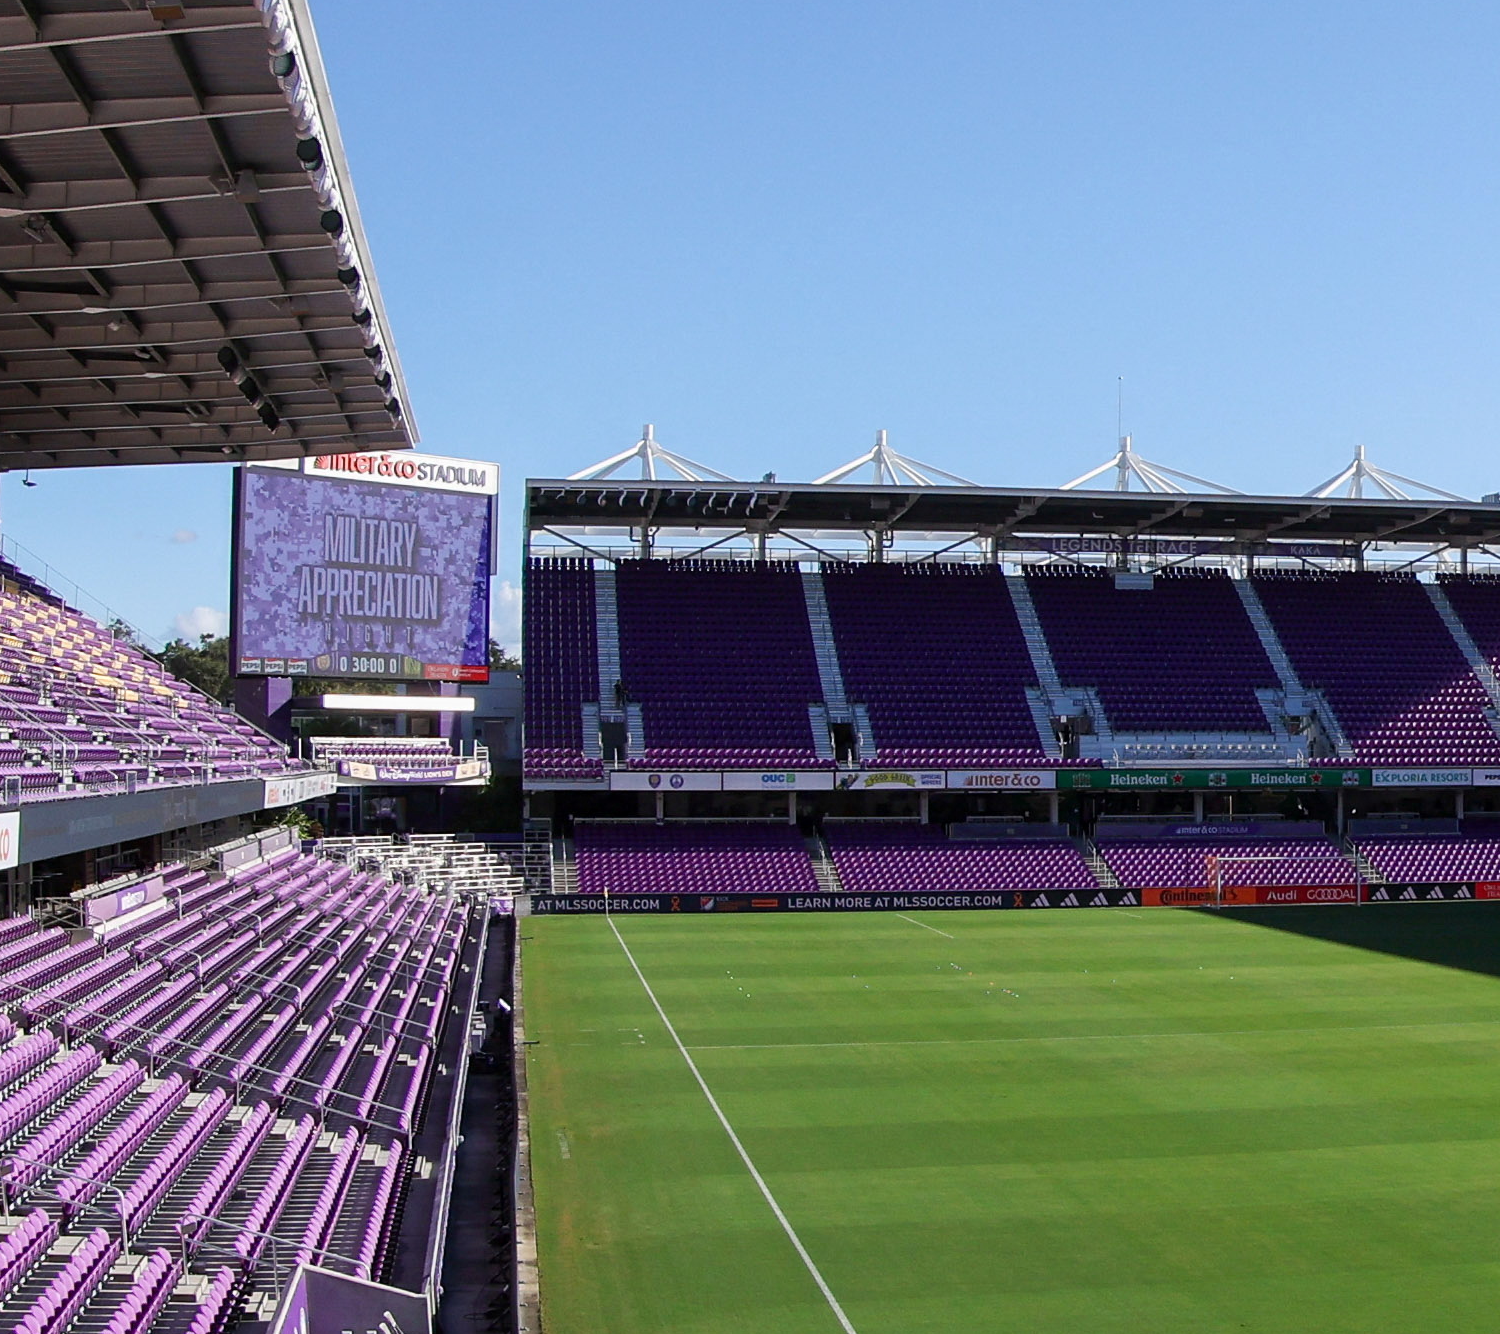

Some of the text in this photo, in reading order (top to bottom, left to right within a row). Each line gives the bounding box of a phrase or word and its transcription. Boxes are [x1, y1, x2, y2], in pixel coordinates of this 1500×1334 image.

[417, 462, 486, 487] STADIUM
[324, 515, 418, 568] MILITARY
[1052, 538, 1122, 553] LEGENDS
[298, 567, 440, 621] APPRECIATION
[323, 623, 415, 645] NIGHT
[340, 656, 397, 674] 0 30:00 0
[1110, 773, 1167, 785] Heineken
[1251, 773, 1306, 785] Heineken
[1430, 771, 1469, 783] RESORTS
[788, 896, 1002, 908] LEARN MORE AT MLSSOCCER.COM
[1267, 890, 1297, 901] Audi
[538, 899, 660, 910] AT MLSSOCCER.COM
